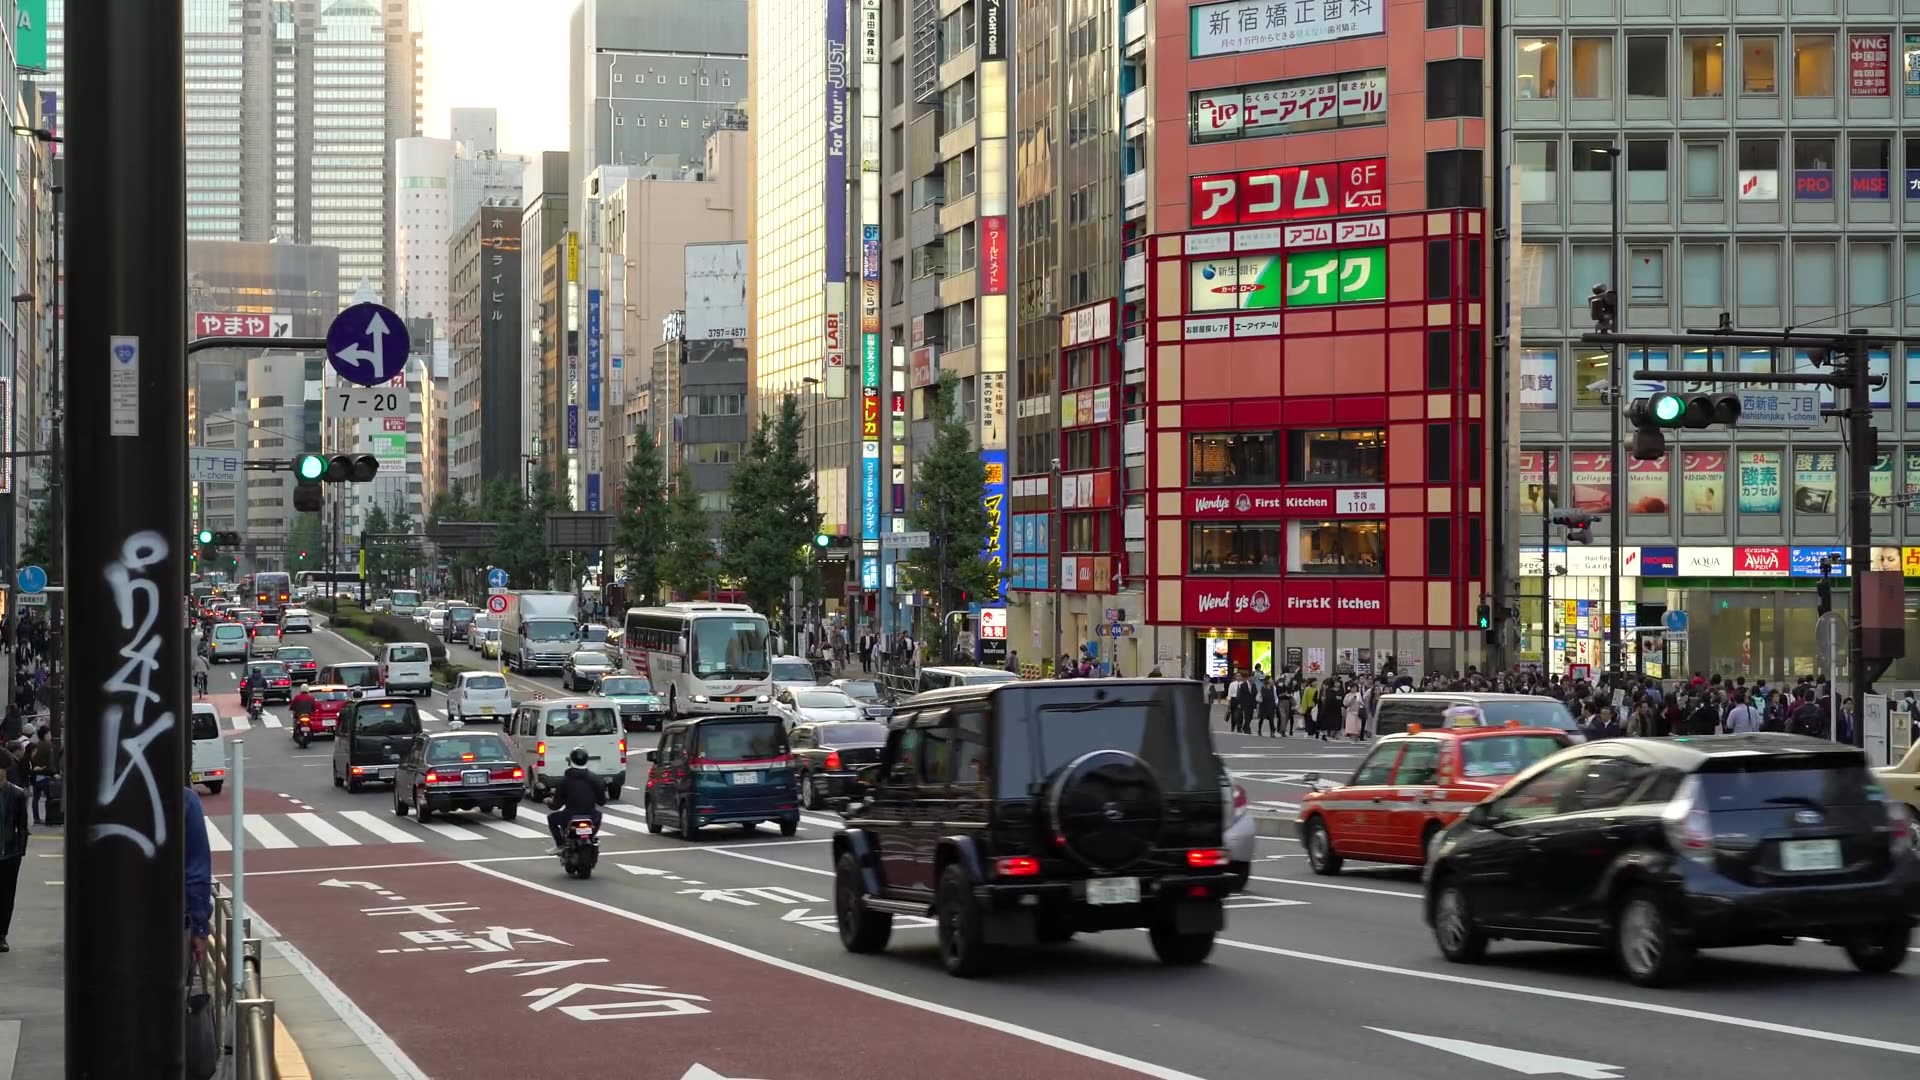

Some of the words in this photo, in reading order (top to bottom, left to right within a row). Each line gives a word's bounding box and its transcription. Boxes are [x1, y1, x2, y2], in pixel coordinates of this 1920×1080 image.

[1209, 0, 1373, 36] 新宿矯正歯科
[1852, 39, 1887, 48] YING
[1851, 51, 1887, 61] 中国語
[828, 40, 845, 89] JUST
[1244, 90, 1383, 125] エーアイアール
[830, 137, 843, 156] For
[1351, 165, 1377, 186] 6F
[1797, 177, 1830, 192] PRO
[1853, 177, 1887, 192] MISE
[1202, 170, 1330, 220] アコム
[1361, 194, 1382, 208] 入口
[864, 226, 878, 238] 6F
[1289, 228, 1328, 244] アコム
[1342, 223, 1380, 240] アコム
[990, 231, 999, 285] ワールドメイト
[1218, 264, 1258, 277] 新生銀行
[1287, 256, 1371, 297] レイク
[1221, 284, 1257, 293] カードローン
[202, 316, 265, 335] やまや
[828, 314, 838, 349] LABI
[1186, 324, 1229, 334] お部屋探し7F
[1235, 321, 1279, 331] エーアイアール
[1520, 374, 1552, 391] 賃貸
[864, 387, 877, 396] 3F
[1743, 395, 1814, 412] 西新宿一丁目
[588, 415, 599, 424] 6F
[864, 398, 877, 433] トレカ
[1788, 412, 1817, 421] 1-chome
[1684, 455, 1722, 470] シン
[1753, 453, 1766, 465] 24
[1796, 455, 1834, 471] 酸素
[984, 465, 1003, 483] 薬
[1741, 466, 1777, 486] 酸素
[1353, 491, 1367, 500] 客席
[1742, 487, 1777, 496] カプセル
[1195, 495, 1229, 512] Wendy's
[1255, 498, 1280, 507] First
[1286, 497, 1328, 507] Kitchen
[1691, 556, 1721, 566] AQUA
[982, 626, 1005, 637] 免税
